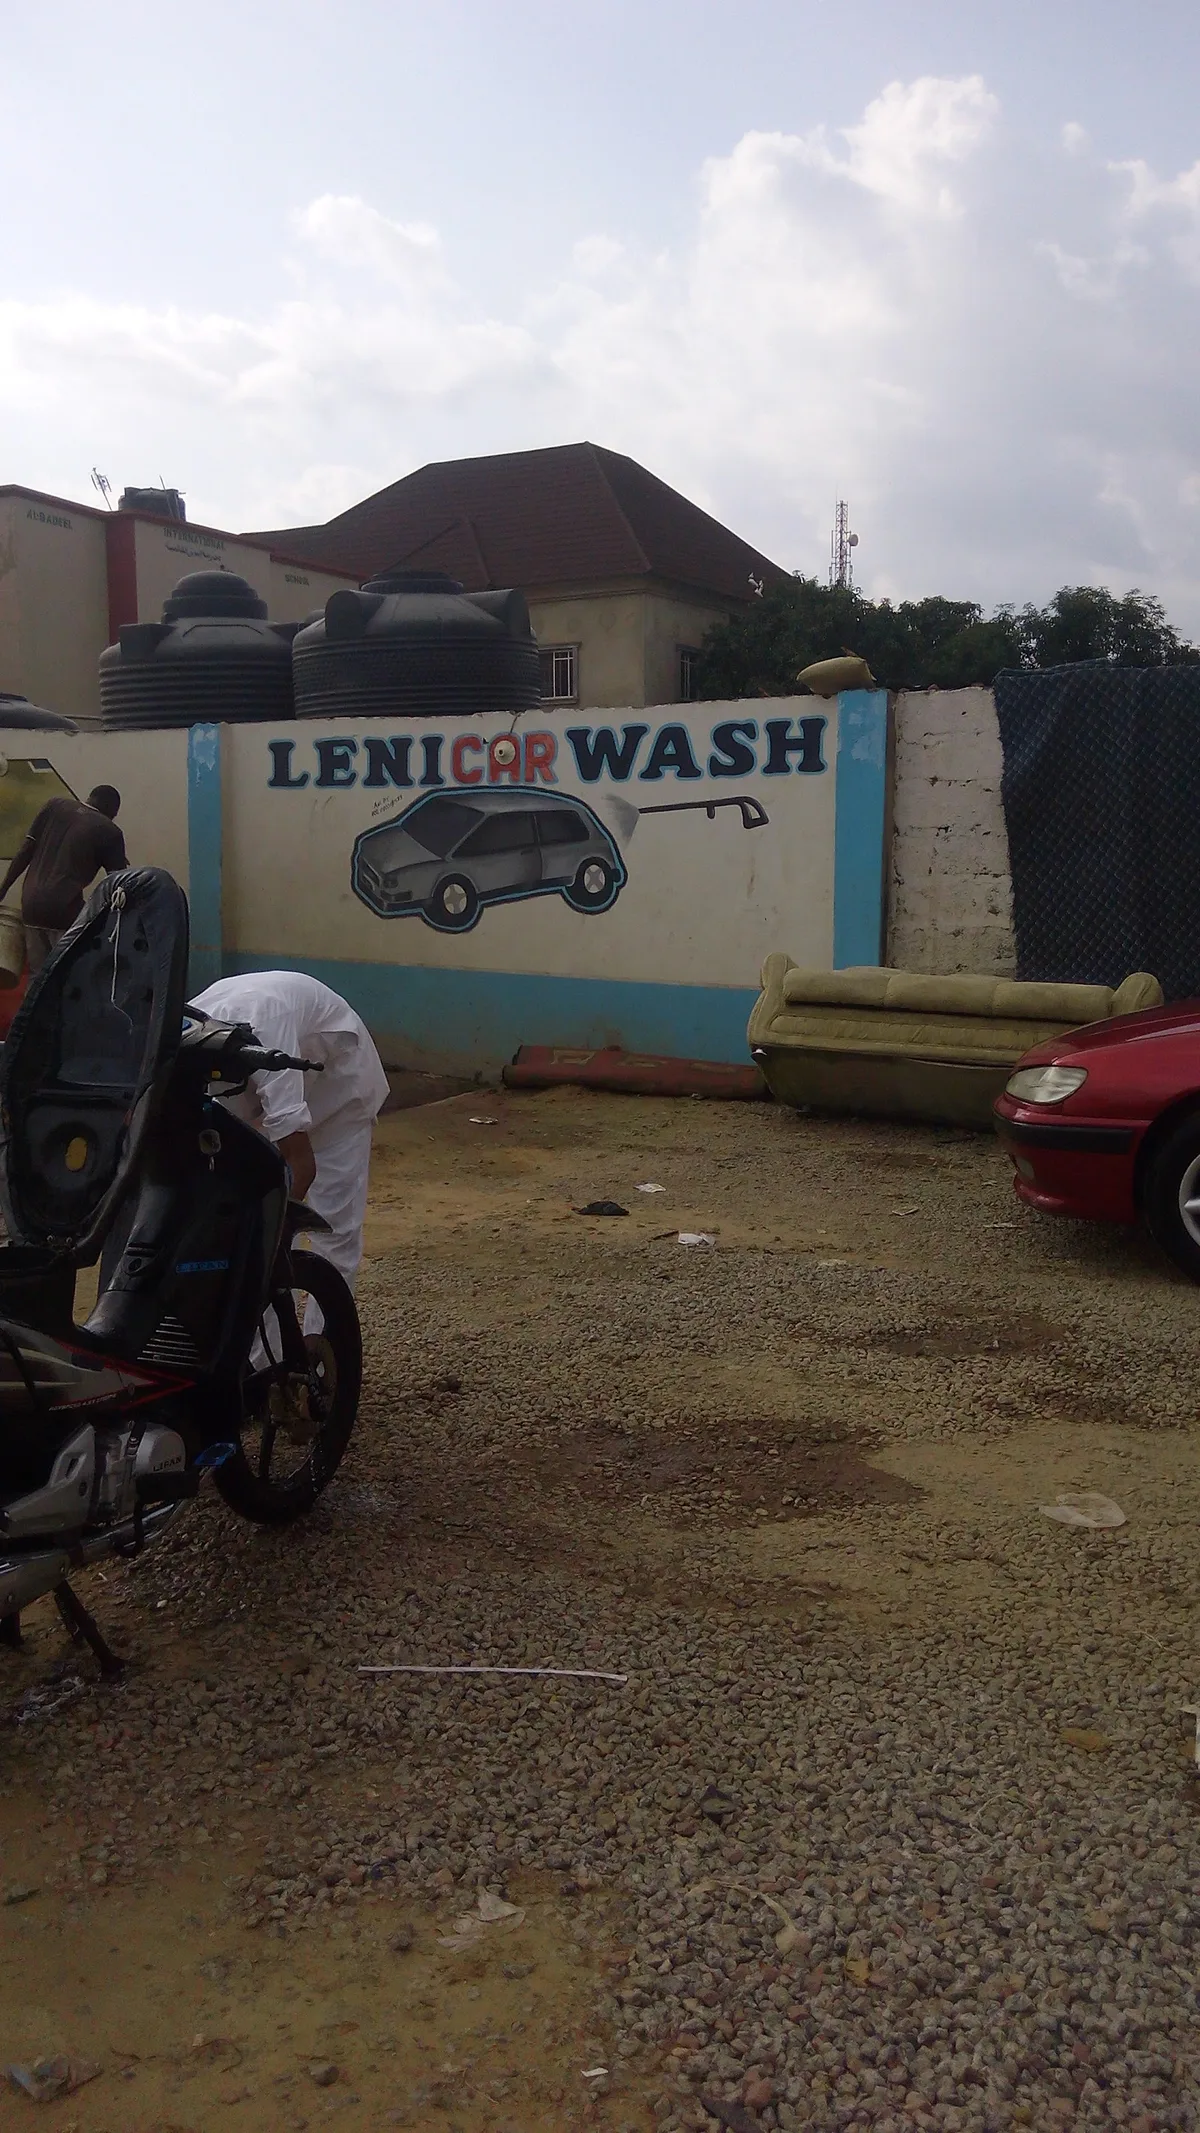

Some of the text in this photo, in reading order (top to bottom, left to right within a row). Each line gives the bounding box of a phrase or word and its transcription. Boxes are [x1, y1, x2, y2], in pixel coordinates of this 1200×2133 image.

[163, 527, 226, 551] INTERNATIONAL
[267, 715, 828, 788] LENI CAR WASH
[153, 1455, 182, 1472] LIFAN
